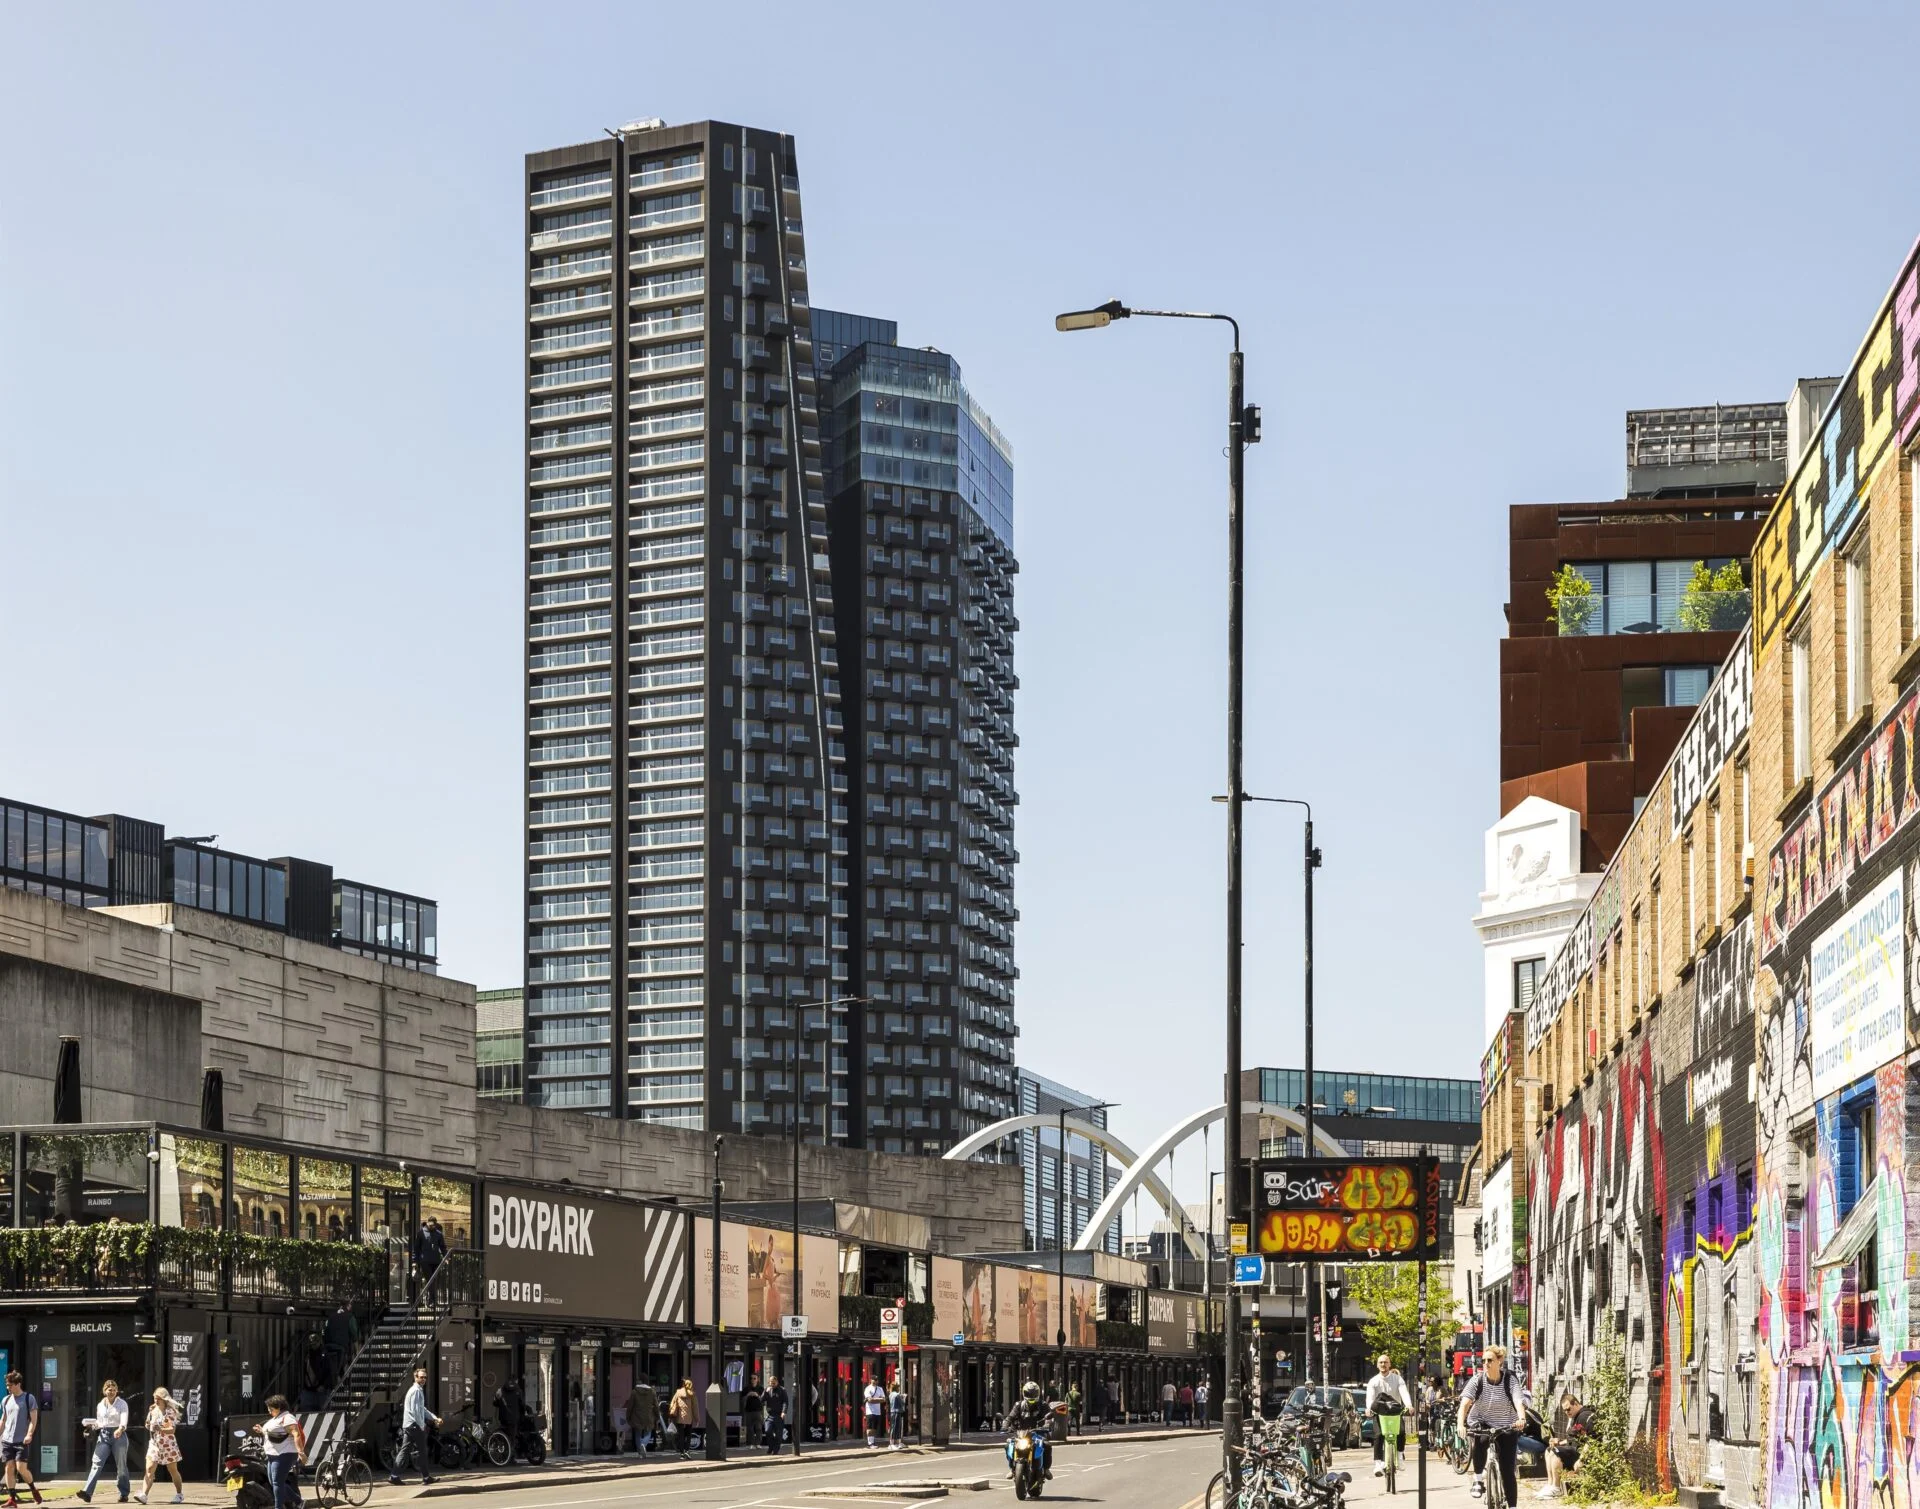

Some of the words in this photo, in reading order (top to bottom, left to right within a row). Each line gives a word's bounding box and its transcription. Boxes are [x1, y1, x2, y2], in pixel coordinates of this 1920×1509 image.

[1813, 942, 1835, 984] TOWER
[1835, 901, 1884, 967] VENTILATIONS
[1886, 888, 1900, 929] LTD
[88, 1198, 112, 1206] RAINBO
[489, 1194, 594, 1256] BOXPARK
[1148, 1296, 1175, 1323] BOXPARK
[28, 1324, 38, 1333] 37
[70, 1323, 112, 1333] BARCLAYS
[173, 1335, 183, 1344] THE
[183, 1335, 193, 1344] NEW
[172, 1343, 188, 1352] BLACK
